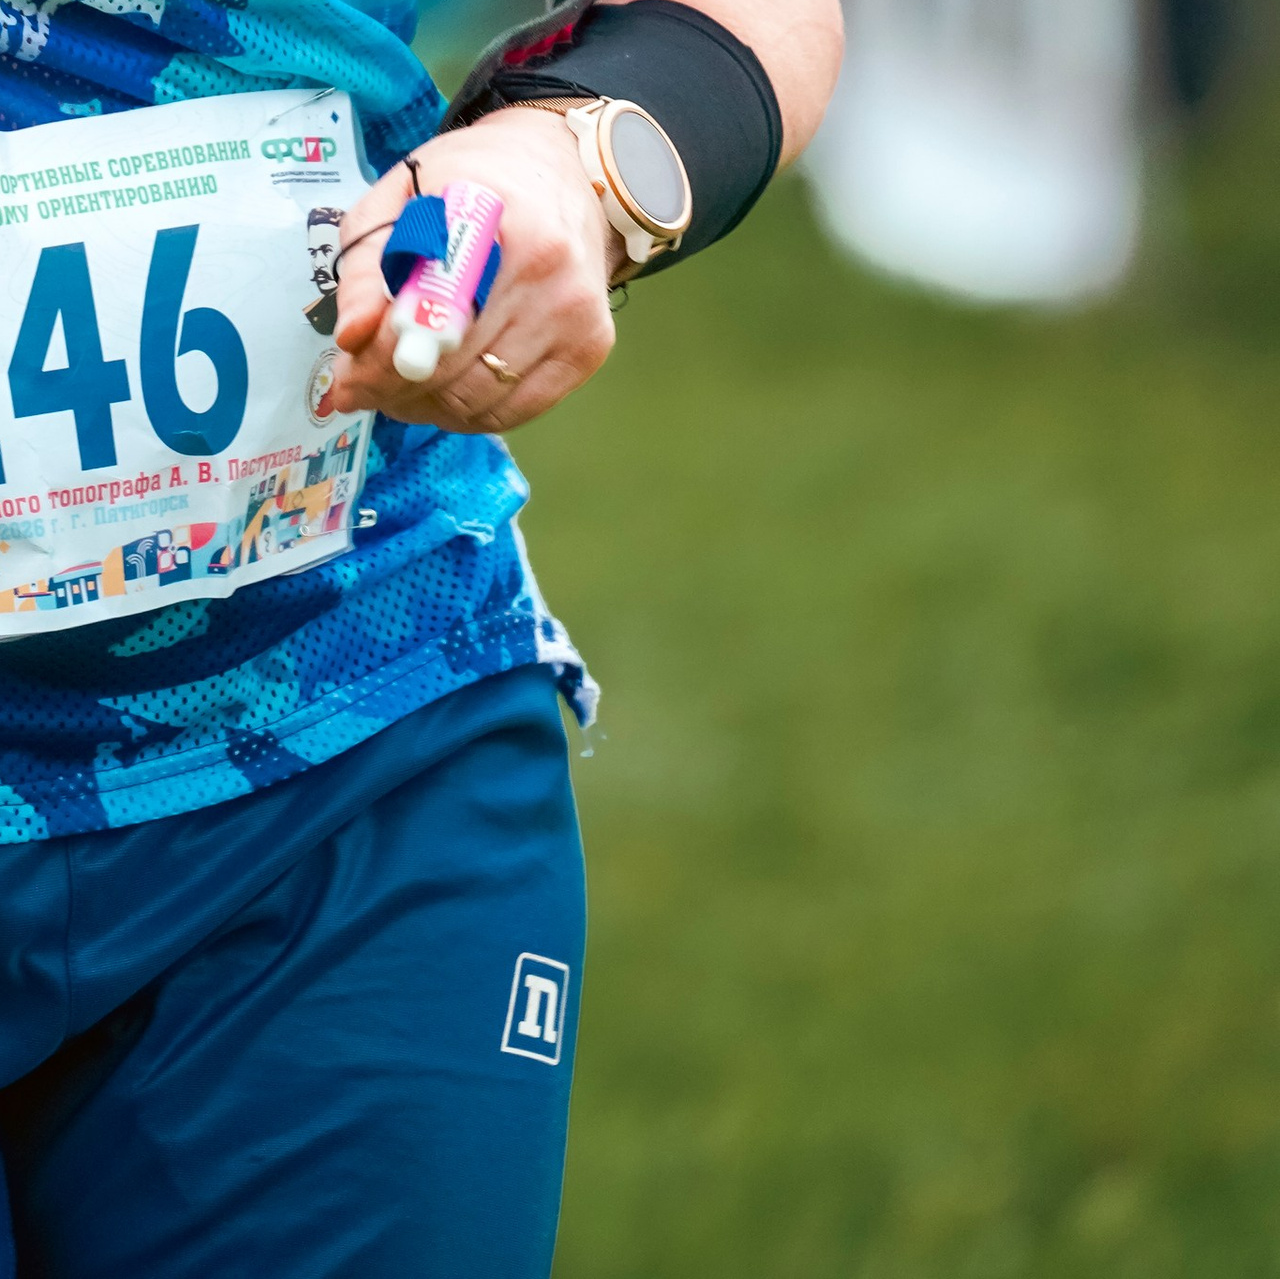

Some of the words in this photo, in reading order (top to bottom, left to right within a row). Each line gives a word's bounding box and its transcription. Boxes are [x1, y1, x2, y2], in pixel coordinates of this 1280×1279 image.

[107, 139, 251, 179] СОРЕВНОВАНИЯ
[37, 174, 218, 220] ОРИЕНТИРОВАНИЮ
[48, 472, 162, 509] топографа
[169, 465, 188, 488] А.
[197, 462, 219, 483] В.
[228, 445, 303, 481] Пастухова
[94, 494, 190, 525] Пятигорск
